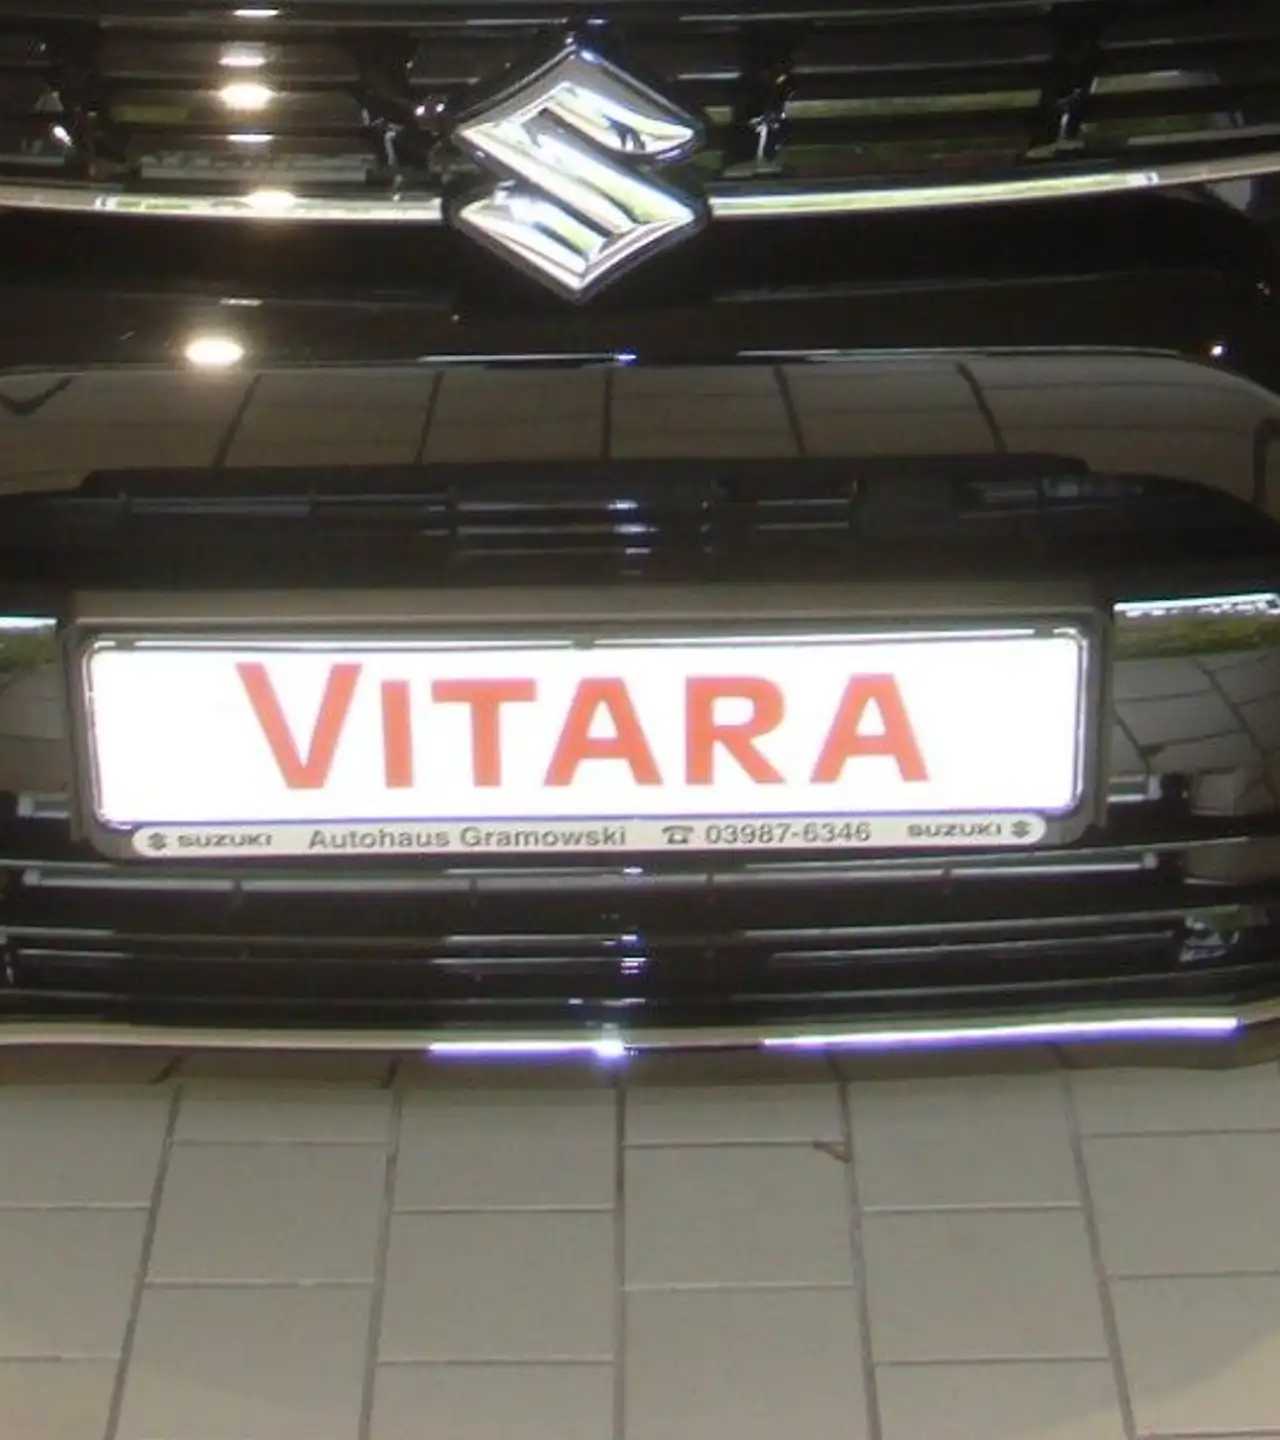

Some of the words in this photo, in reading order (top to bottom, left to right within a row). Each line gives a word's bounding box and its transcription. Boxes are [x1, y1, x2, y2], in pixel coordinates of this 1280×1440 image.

[235, 661, 929, 790] VITARA
[176, 833, 273, 849] SUZUKI
[308, 827, 450, 851] Autohaus
[459, 824, 626, 848] Gramowski
[704, 822, 872, 845] 03987-6346
[905, 822, 1003, 838] SUZUKI
